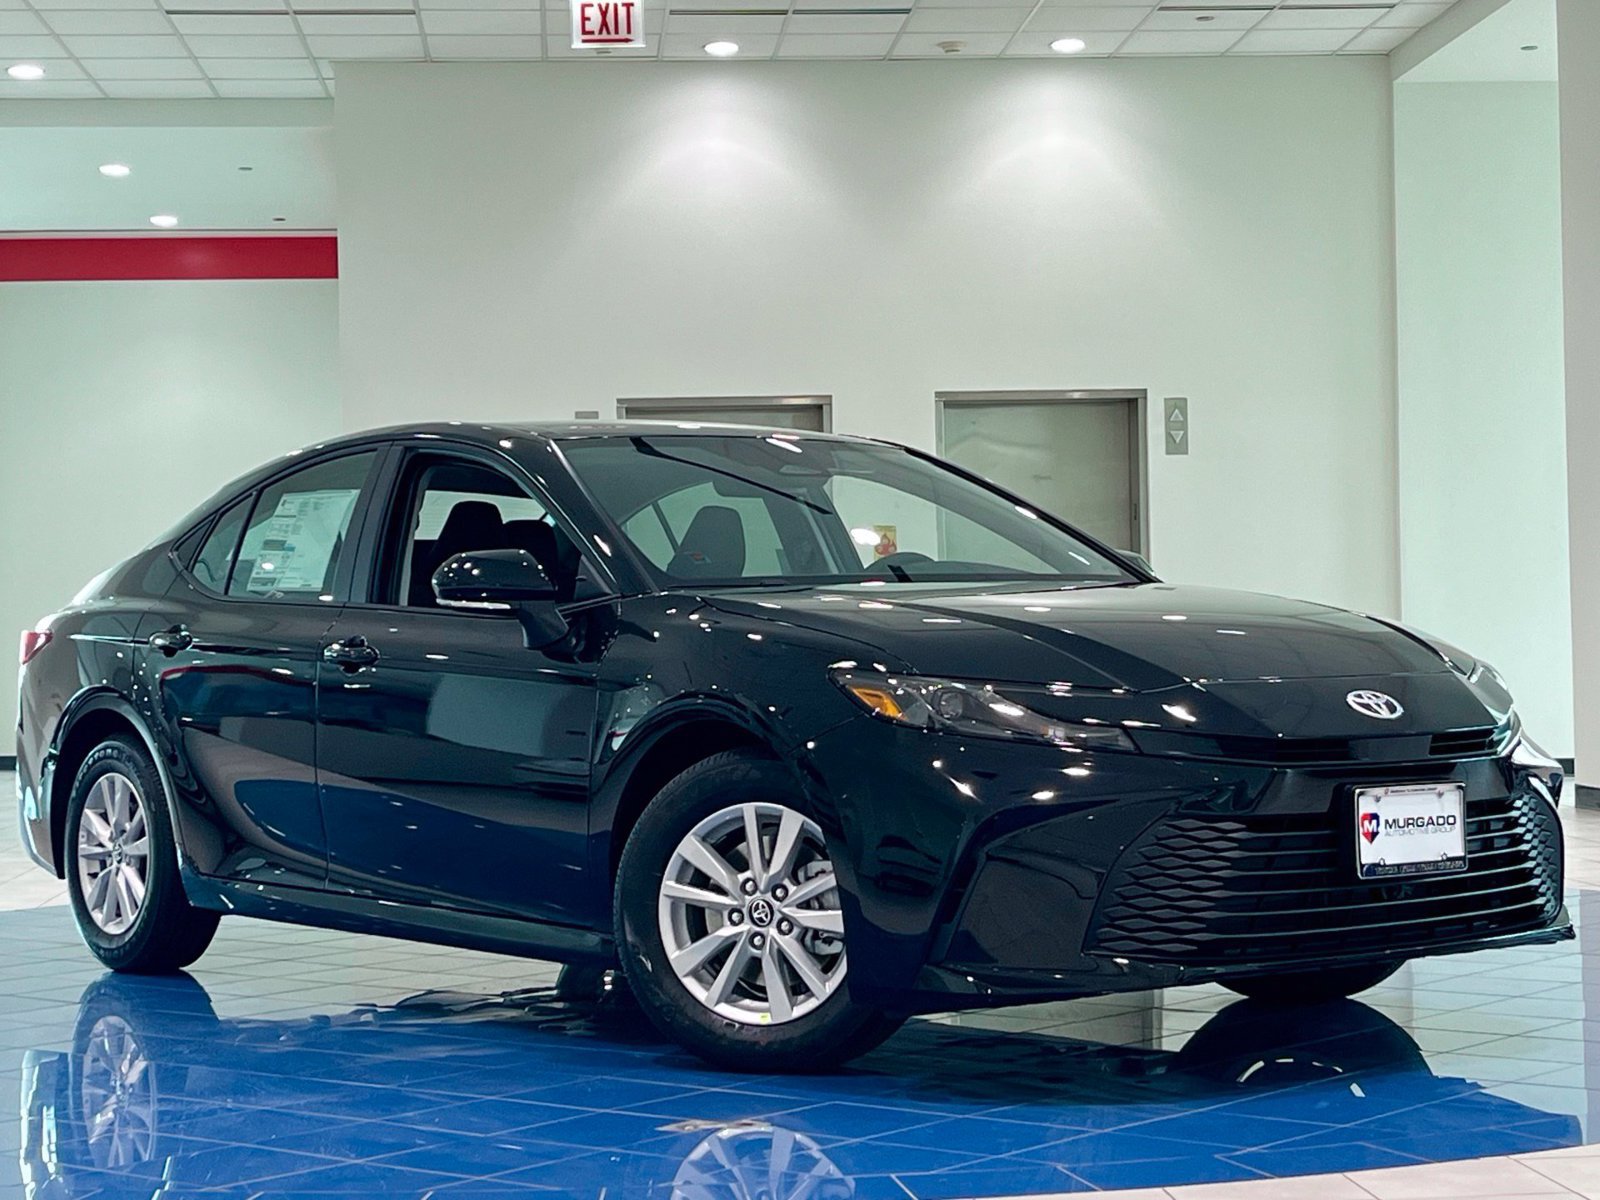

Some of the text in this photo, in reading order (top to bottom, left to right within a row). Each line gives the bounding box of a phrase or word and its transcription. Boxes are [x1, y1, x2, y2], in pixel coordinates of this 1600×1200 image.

[581, 2, 635, 35] EXIT
[1384, 815, 1457, 830] MURGADO
[1431, 825, 1457, 834] GROUP
